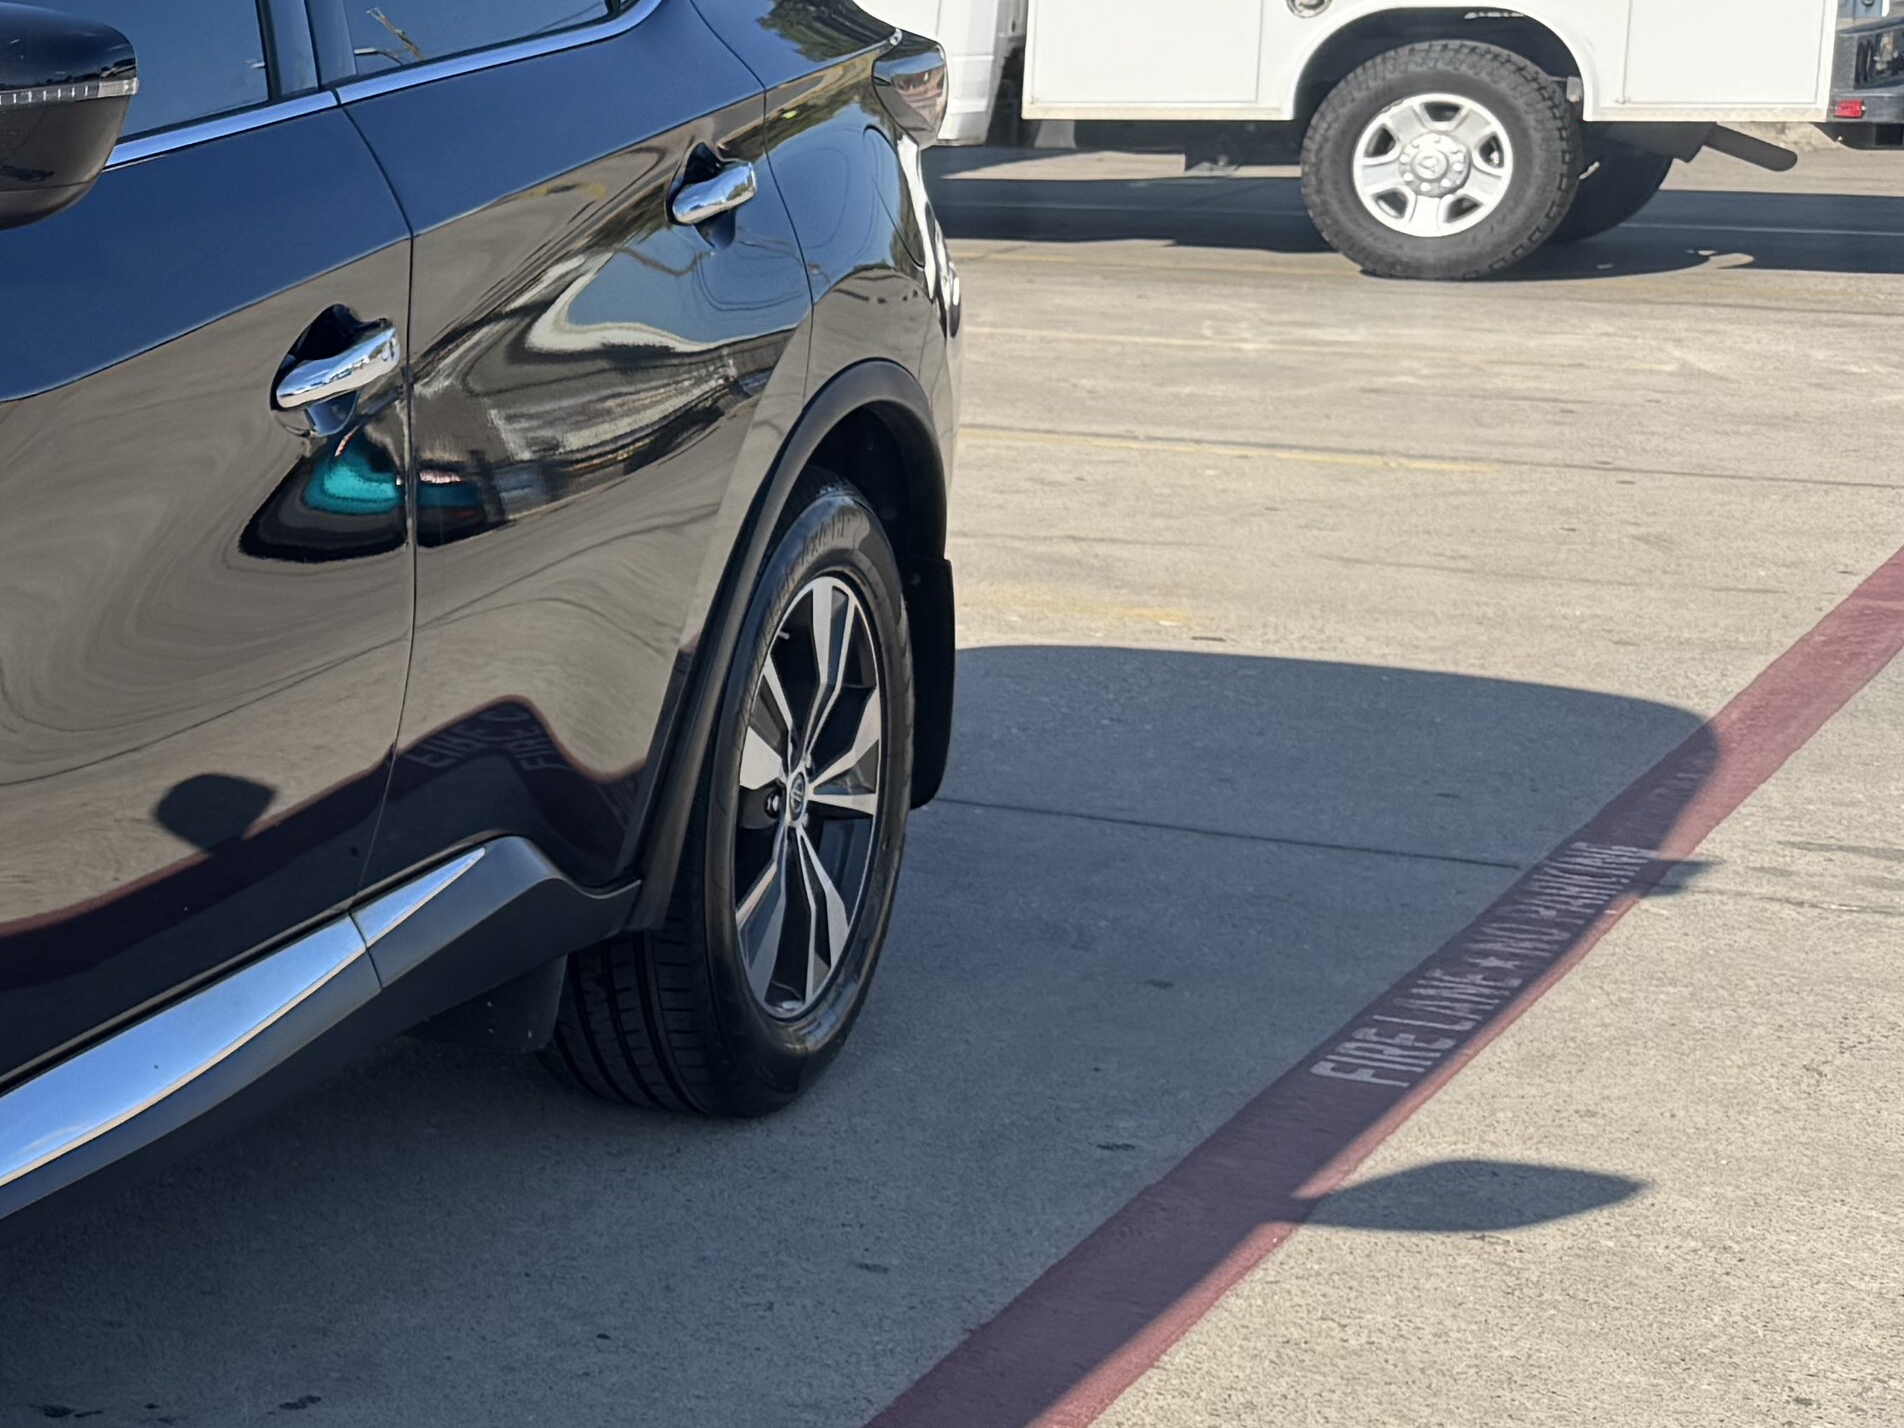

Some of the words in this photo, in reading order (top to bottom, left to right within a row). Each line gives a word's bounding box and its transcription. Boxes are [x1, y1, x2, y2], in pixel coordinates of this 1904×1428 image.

[1496, 842, 1659, 925] PARKING
[1463, 922, 1572, 957] NO
[1373, 968, 1522, 1030] LANE
[1310, 1028, 1456, 1088] FIRE
